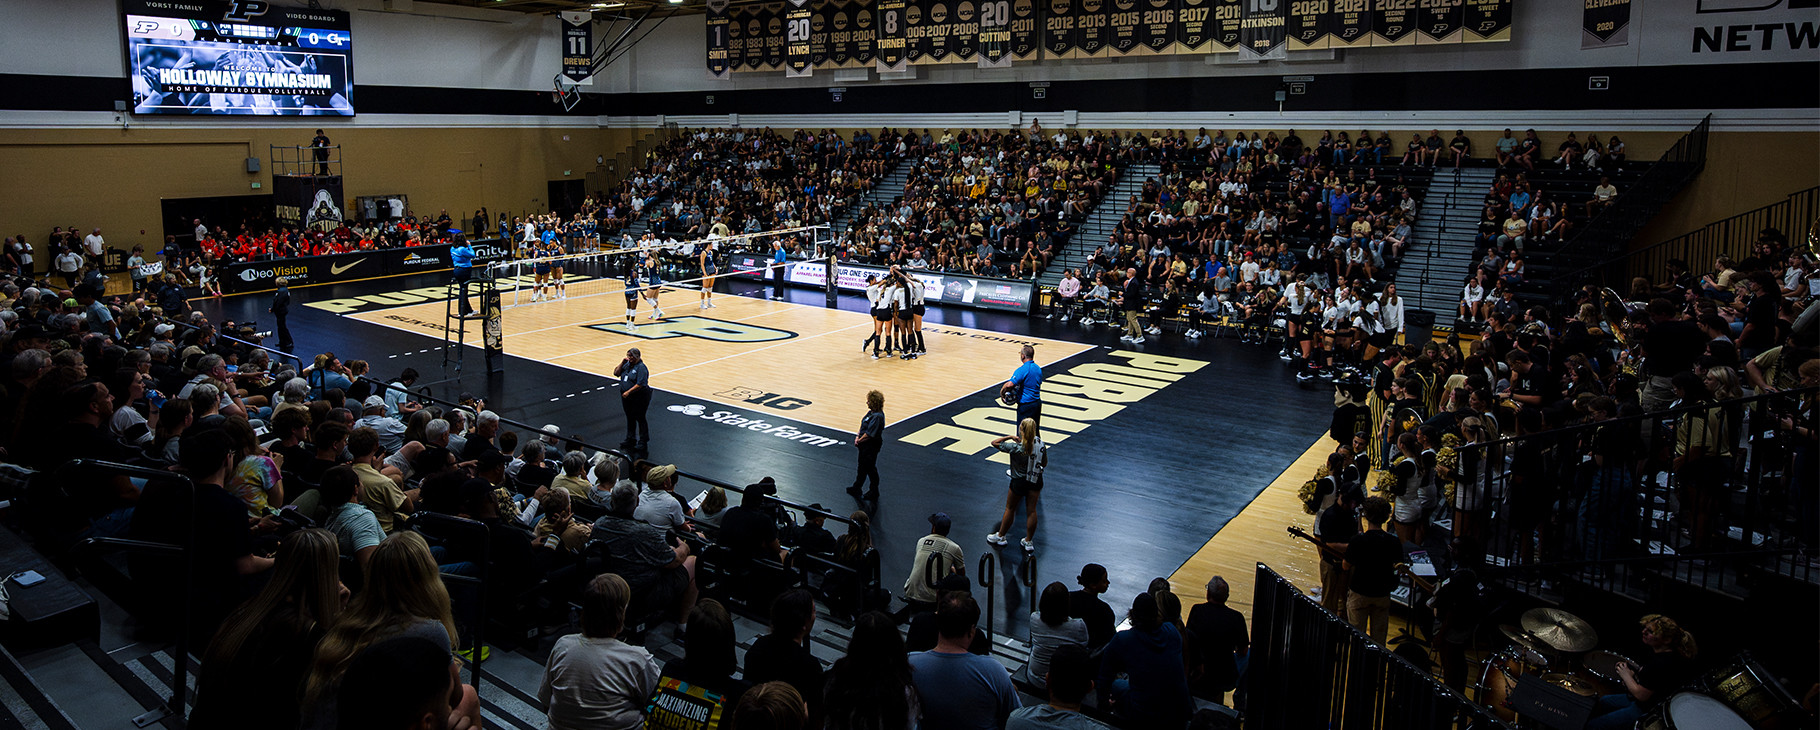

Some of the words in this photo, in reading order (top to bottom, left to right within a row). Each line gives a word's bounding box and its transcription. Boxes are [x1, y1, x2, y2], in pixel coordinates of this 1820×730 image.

[146, 1, 172, 9] VORST
[1291, 0, 1329, 16] 2020
[1334, 0, 1370, 13] 2021
[1477, 4, 1499, 12] SWEET
[308, 14, 336, 22] BOARDS
[980, 1, 1009, 27] 20
[1078, 14, 1106, 28] 2013
[1110, 12, 1140, 27] 2015
[1144, 9, 1174, 24] 2016
[1179, 7, 1210, 22] 2017
[885, 10, 898, 34] 8
[952, 22, 979, 36] 2008
[1011, 18, 1034, 32] 2011
[1047, 16, 1074, 30] 2012
[1241, 17, 1285, 29] ATKINSON
[1596, 21, 1614, 31] 2020
[170, 23, 183, 37] 0
[714, 25, 721, 47] 1
[788, 18, 810, 42] 20
[830, 31, 851, 43] 1990
[852, 29, 876, 42] 2004
[906, 26, 926, 39] 006
[926, 24, 952, 38] 2007
[978, 31, 1011, 43] CUTTINO
[309, 32, 319, 45] 0
[729, 39, 743, 49] 982
[746, 37, 763, 49] 1983
[812, 32, 828, 44] 987
[877, 37, 906, 49] TURNER
[1254, 40, 1270, 48] 2018
[1692, 22, 1820, 53] NETW
[568, 36, 586, 54] 11
[788, 45, 810, 56] LYNCH
[564, 57, 591, 66] DREWS
[708, 50, 728, 59] SMITH
[159, 68, 241, 87] HOLLOWAY
[245, 71, 332, 89] GYMNASIUM
[276, 204, 301, 221] PURDUE
[849, 268, 862, 277] ONE
[862, 270, 880, 279] STOP
[920, 327, 968, 337] ELIN
[970, 334, 1044, 346] COURT
[656, 692, 709, 723] MAXIMIZING
[652, 706, 705, 730] STUDENT
